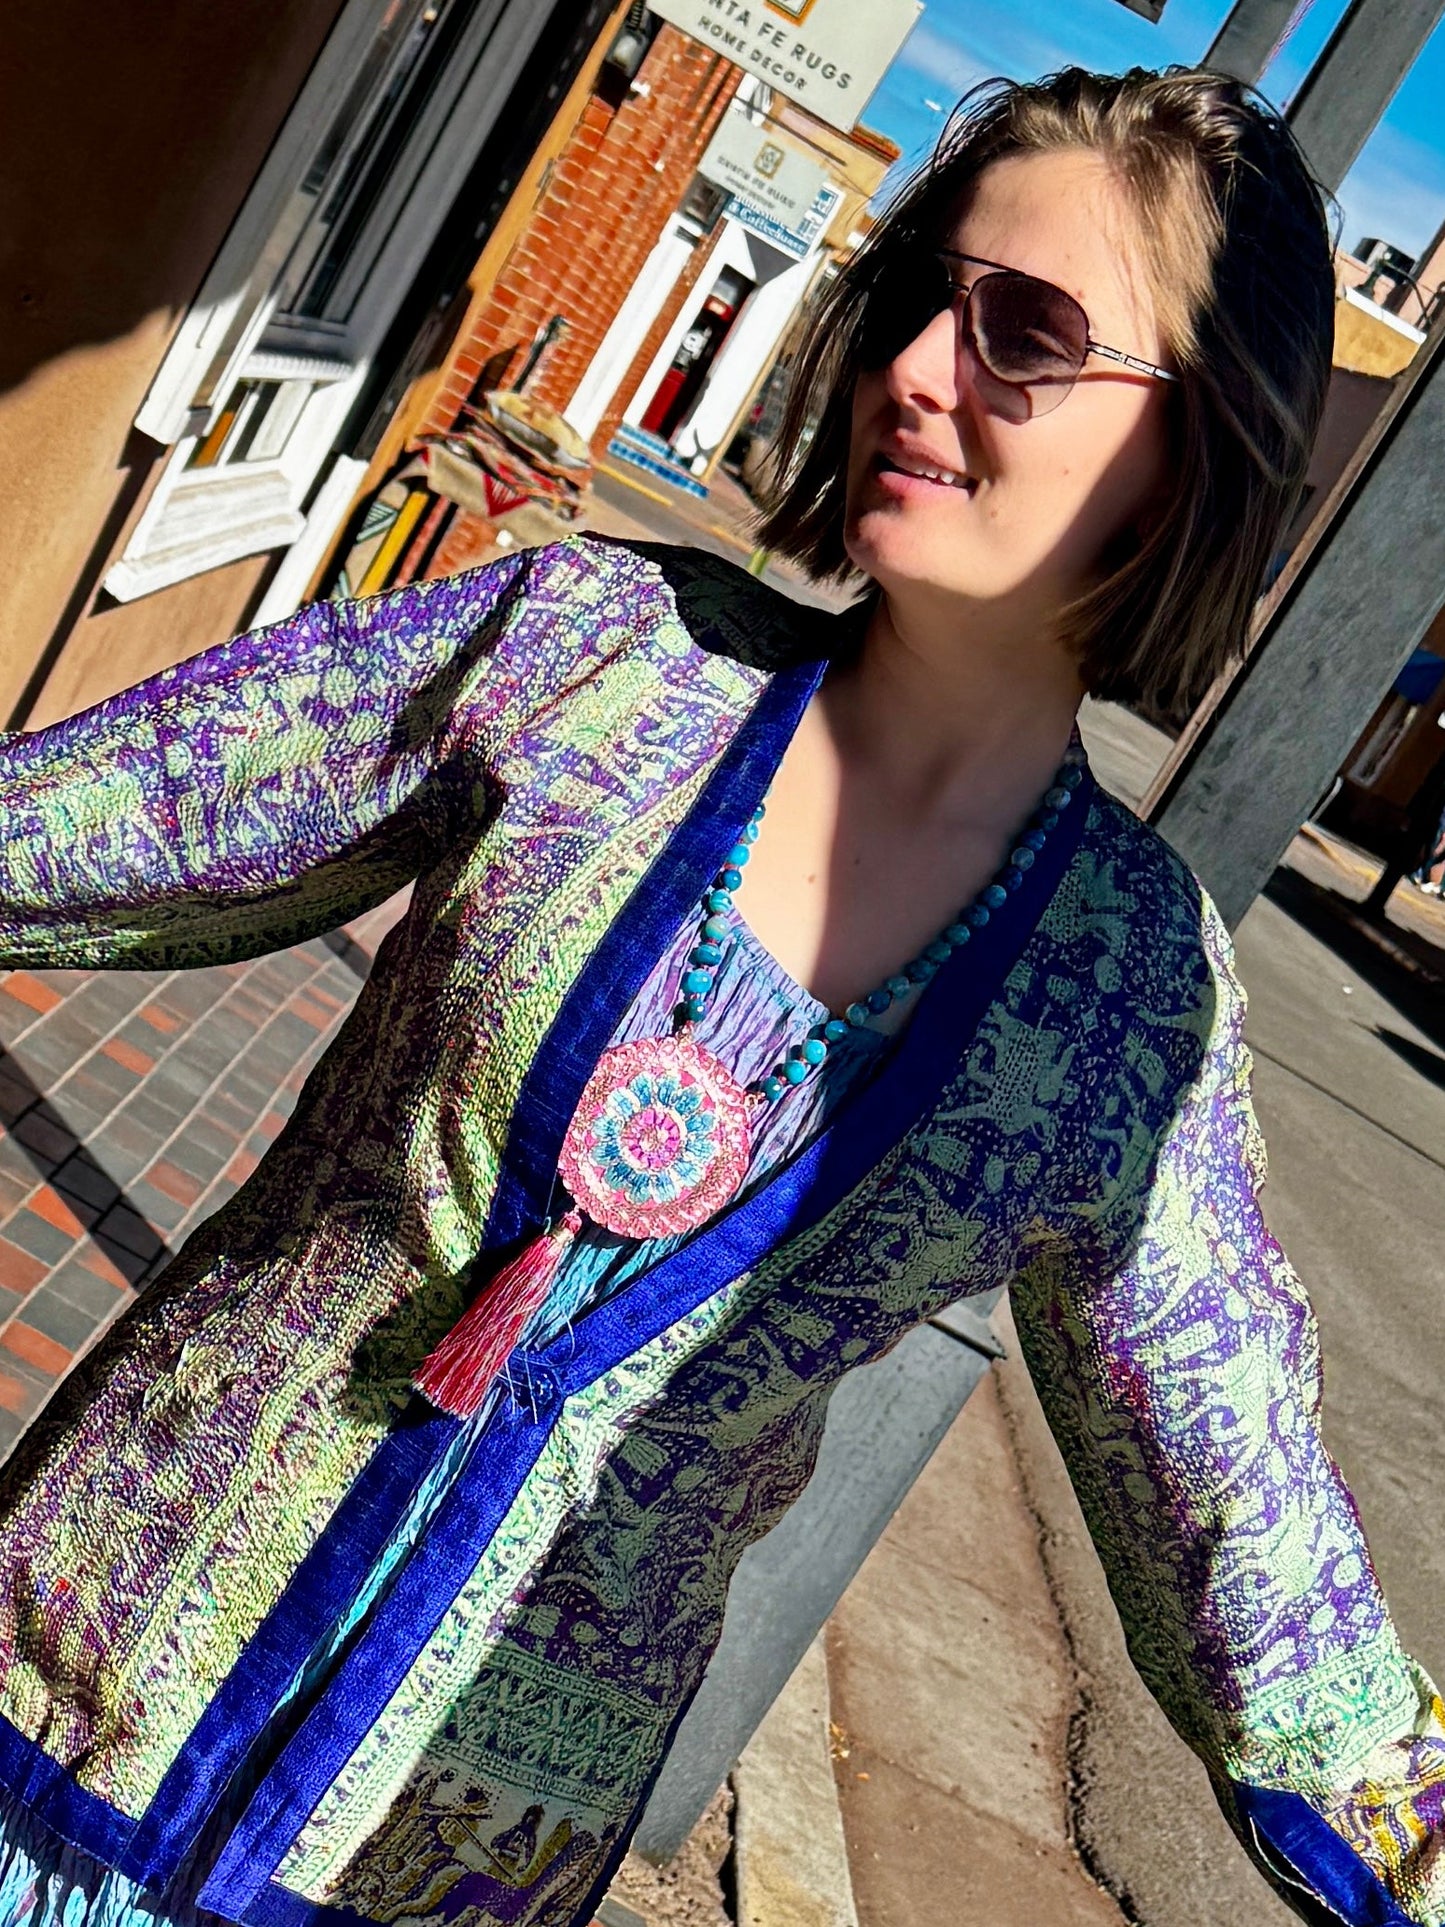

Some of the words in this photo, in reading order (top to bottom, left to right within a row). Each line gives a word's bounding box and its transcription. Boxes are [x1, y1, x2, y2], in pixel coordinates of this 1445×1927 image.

[698, 16, 747, 53] HOME
[750, 49, 808, 90] DECOR
[757, 22, 787, 48] FE
[790, 43, 852, 89] RUGS
